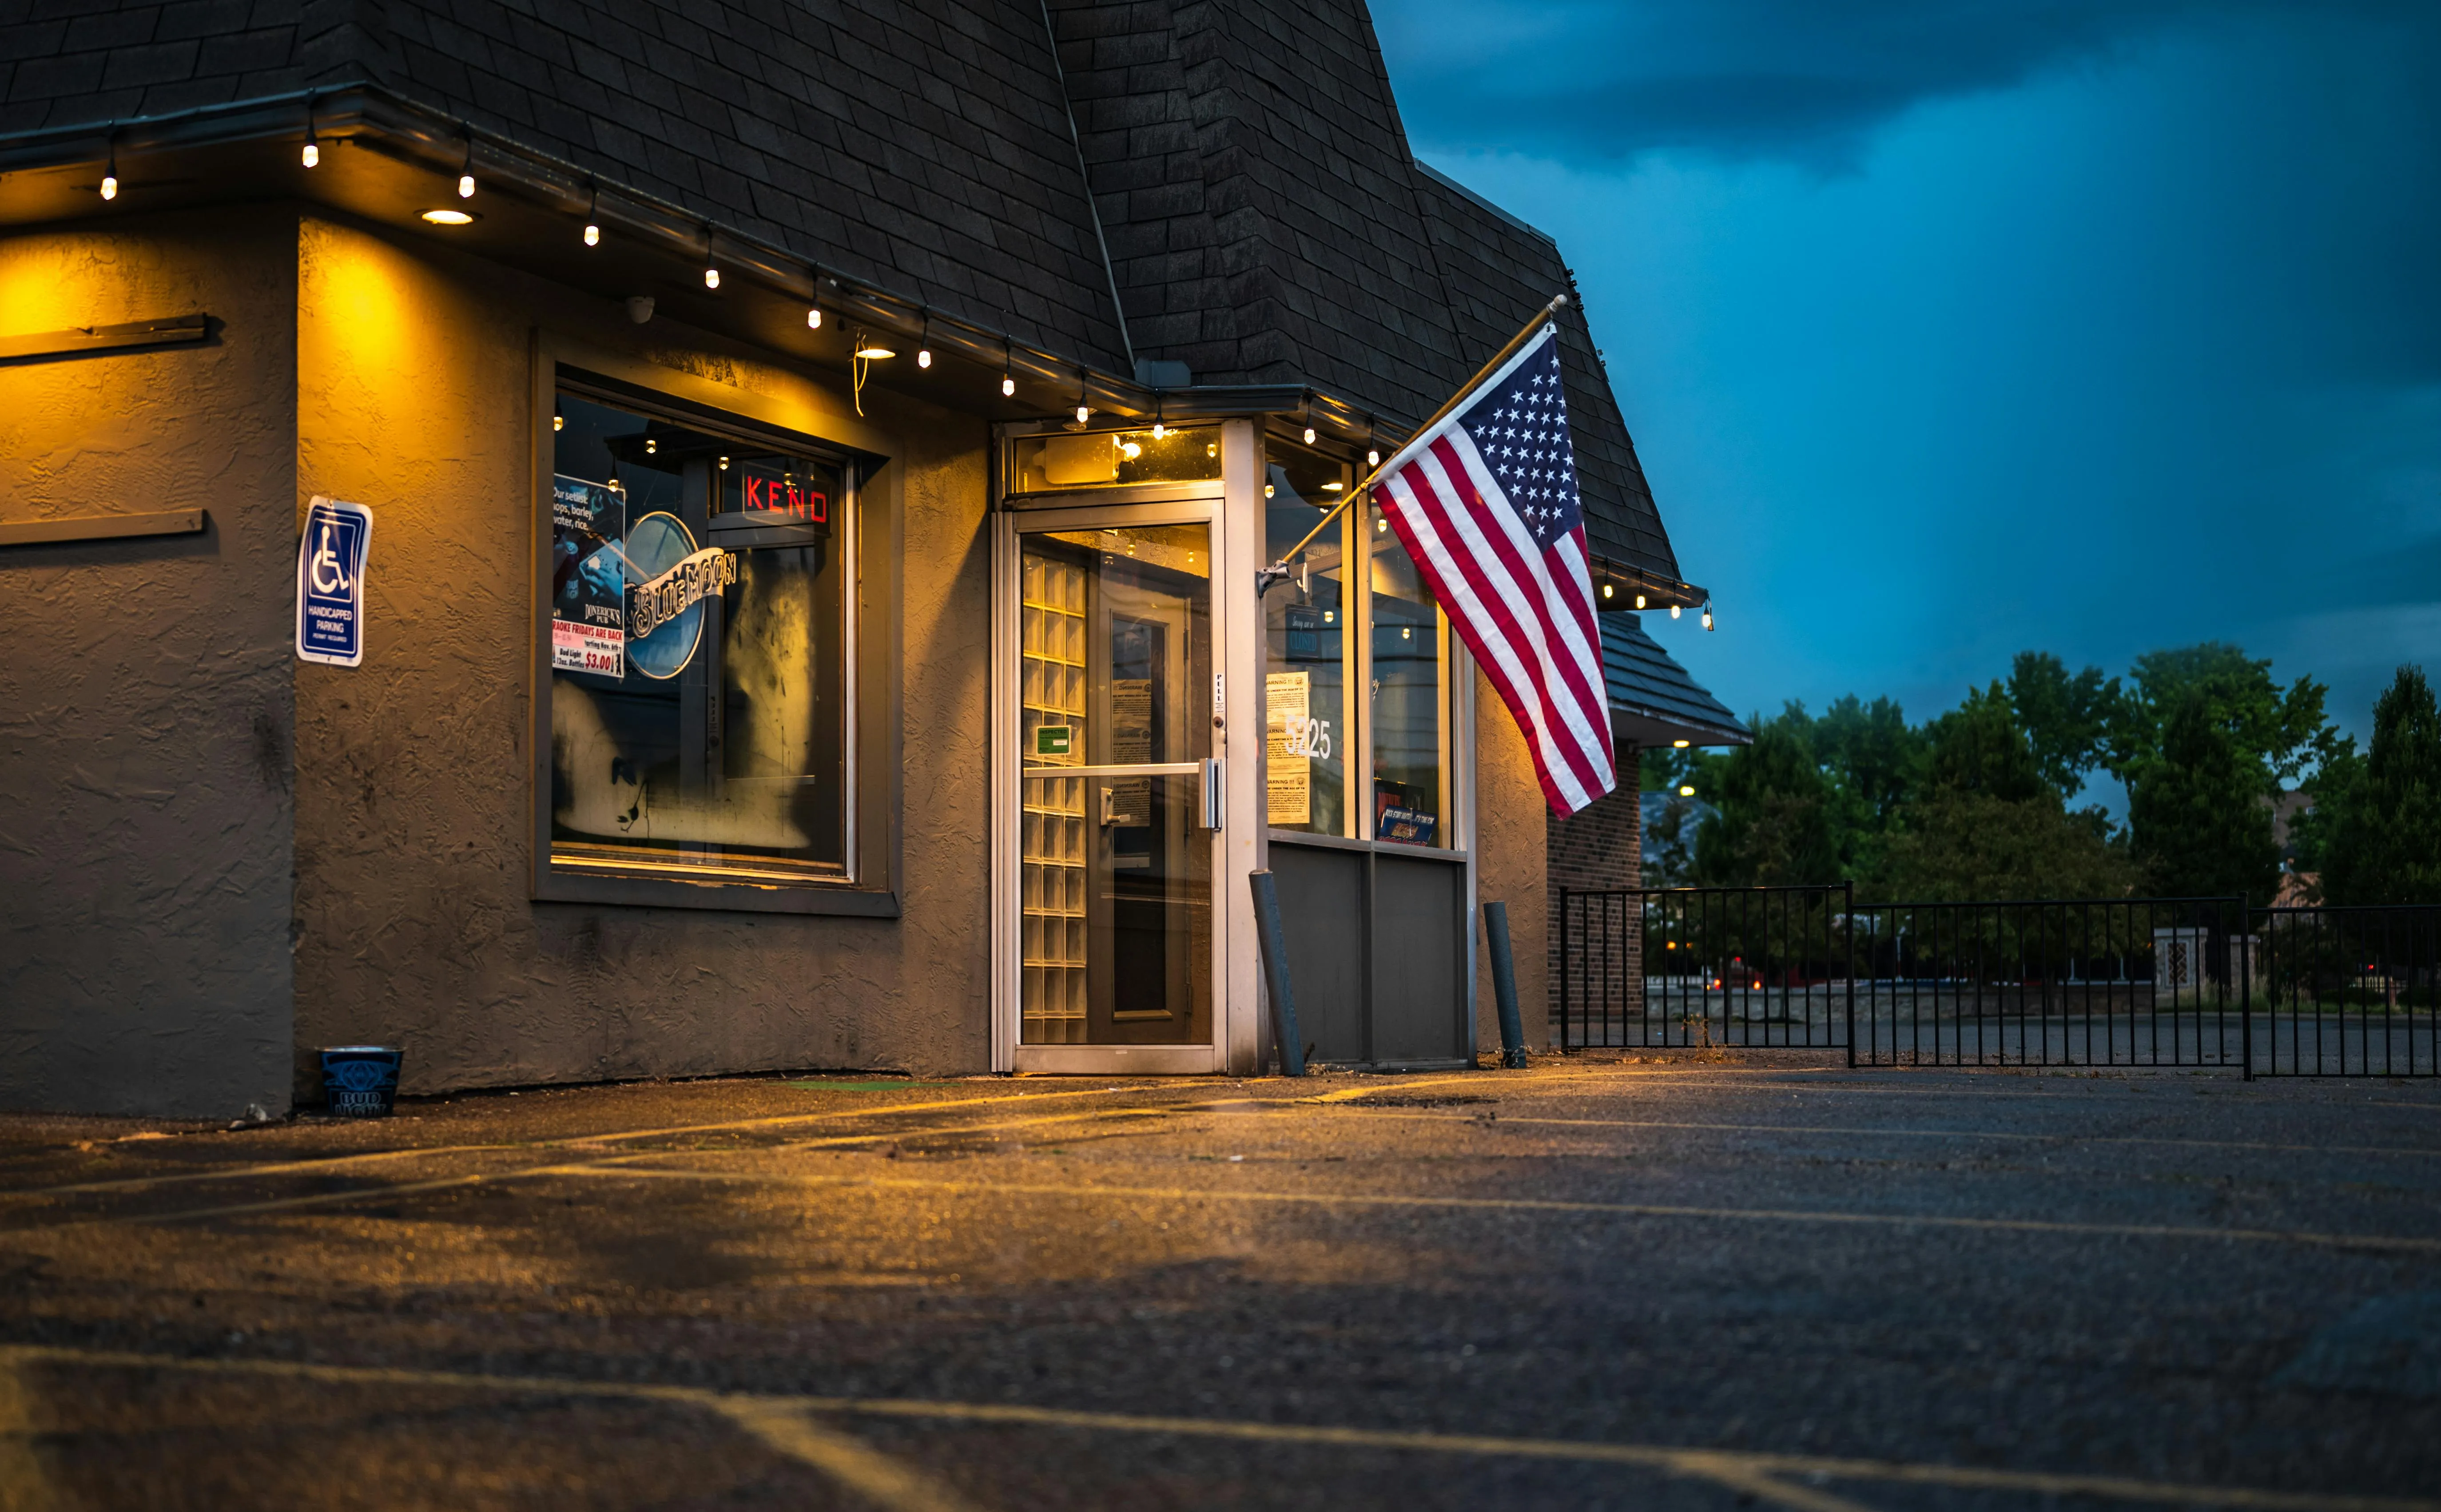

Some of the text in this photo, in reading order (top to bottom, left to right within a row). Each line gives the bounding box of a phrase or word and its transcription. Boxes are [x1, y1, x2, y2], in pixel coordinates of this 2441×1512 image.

[565, 492, 588, 504] setlist:
[747, 476, 826, 523] KENO
[571, 504, 593, 521] barley,
[575, 518, 589, 530] rice.
[308, 604, 353, 621] HANDICAPPED
[585, 604, 620, 625] DONERICK'S
[316, 619, 344, 633] PARKING
[1292, 615, 1303, 630] Sorry
[572, 624, 594, 636] FRIDAYS
[596, 628, 606, 639] ARE
[608, 630, 622, 641] BACK
[1290, 632, 1317, 651] CLOSED
[570, 649, 581, 659] Light
[585, 651, 611, 671] $3.00
[569, 659, 584, 668] Bottles
[1286, 715, 1331, 759] 5225
[339, 1092, 382, 1105] BUD
